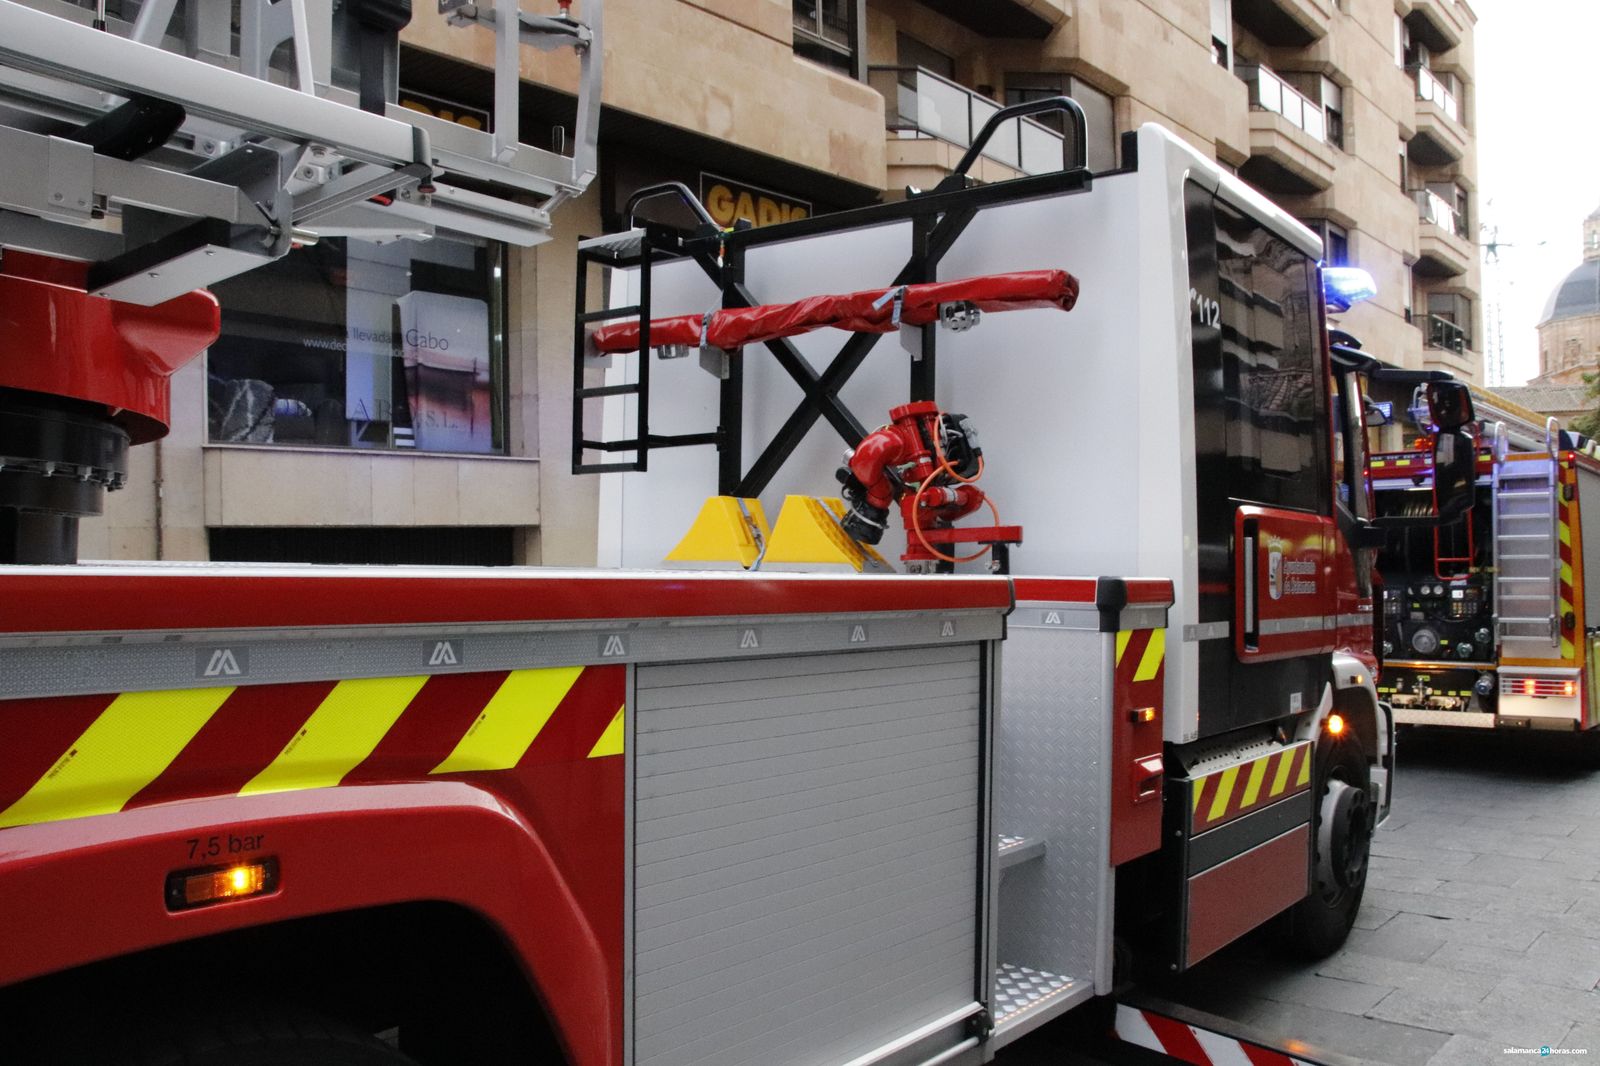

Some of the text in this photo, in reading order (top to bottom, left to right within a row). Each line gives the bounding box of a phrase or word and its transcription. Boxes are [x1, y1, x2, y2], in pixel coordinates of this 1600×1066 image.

[1196, 294, 1221, 330] 112
[352, 327, 449, 350] llevada Cabo
[186, 833, 264, 860] 7,5 bar
